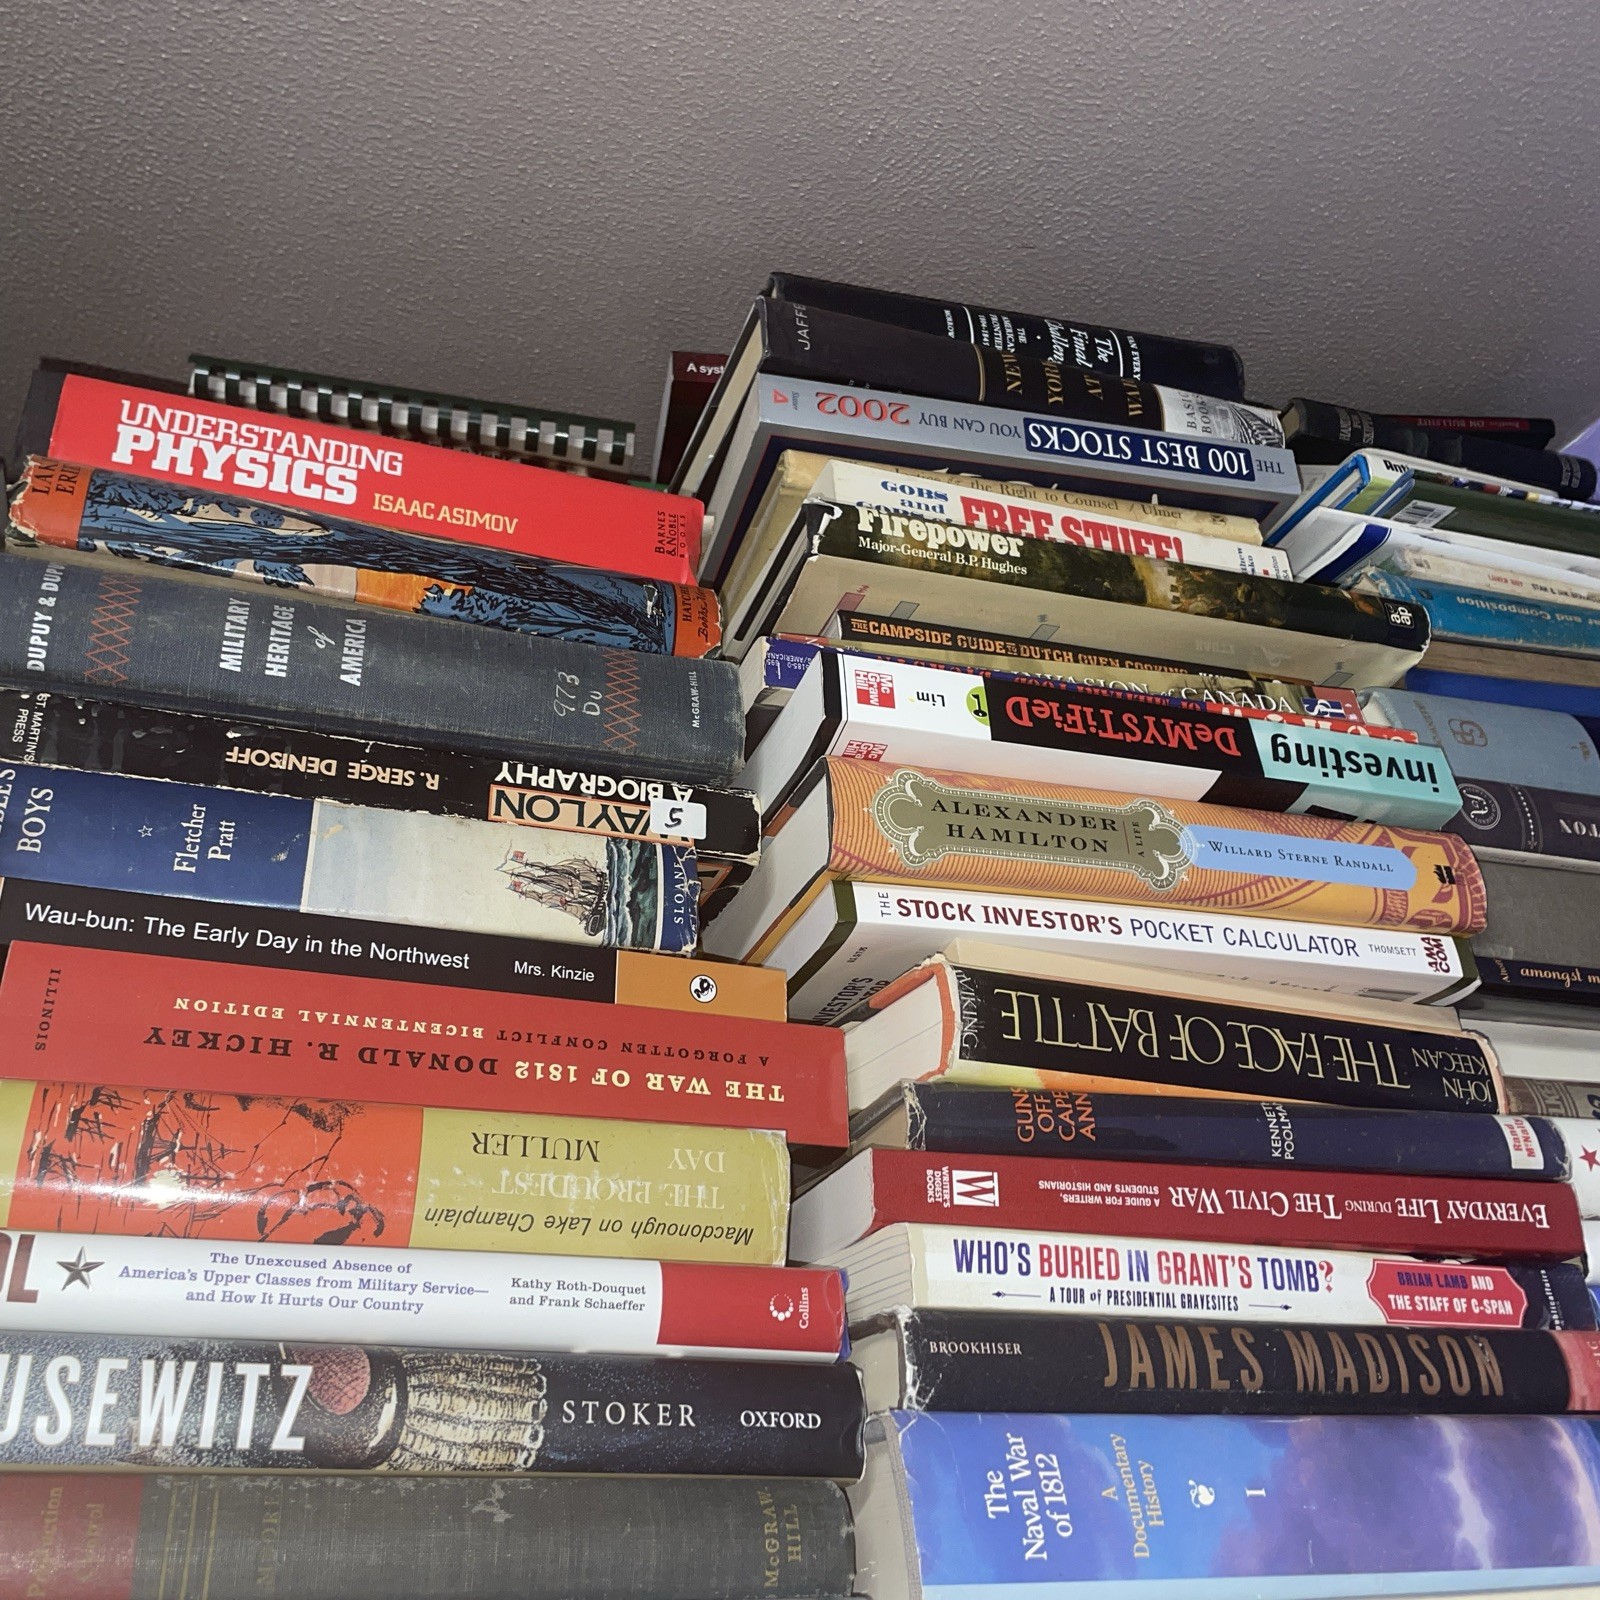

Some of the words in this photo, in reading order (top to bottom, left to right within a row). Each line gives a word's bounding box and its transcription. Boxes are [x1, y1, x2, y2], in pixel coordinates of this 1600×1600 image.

[943, 309, 955, 339] MORROW
[1016, 327, 1028, 344] THE
[1070, 327, 1093, 369] Final
[1094, 336, 1114, 363] The
[1131, 350, 1142, 381] EVERY
[815, 391, 911, 426] 2002
[918, 410, 949, 429] BUY
[120, 399, 403, 477] UNDERSTANDING
[952, 416, 985, 434] CAN
[989, 422, 1021, 440] YOU
[1027, 422, 1133, 461] STOCKS
[1140, 438, 1202, 471] BEST
[1208, 447, 1251, 477] 100
[1255, 458, 1286, 475] THE
[111, 423, 358, 506] PHYSICS
[373, 492, 435, 521] ISAAC
[436, 504, 519, 535] ASIMOV
[880, 480, 949, 502] GOBS
[900, 498, 945, 514] and
[1000, 482, 1039, 500] Right
[1063, 488, 1119, 511] Counsel
[1140, 503, 1184, 521] Ulmer
[655, 510, 666, 555] BARNES
[857, 504, 1025, 559] Firepower
[960, 495, 1055, 543] FREE
[857, 535, 952, 563] Major-General
[980, 553, 1028, 577] Hughes
[1456, 595, 1552, 621] Composition
[26, 611, 53, 672] DUPUY
[219, 597, 251, 673] MILITARY
[264, 604, 296, 678] HERITAGE
[339, 618, 367, 687] AMERICA
[868, 620, 952, 647] CAMPSIDE
[956, 634, 1006, 656] GUIDE
[1019, 643, 1074, 664] DUTCH
[553, 671, 580, 718] 973
[855, 671, 869, 690] Hill
[867, 672, 880, 706] Graw
[691, 670, 701, 729] McGRAW-HILL
[916, 690, 946, 707] Lim
[1181, 686, 1297, 714] CANADA
[12, 708, 30, 743] PRESS
[1005, 696, 1242, 757] DeMYSTiFieD
[225, 746, 338, 777] DENISOFF
[347, 762, 415, 787] SERGE
[1270, 733, 1440, 794] investing
[494, 761, 664, 803] BIOGRAPHY
[16, 787, 54, 853] BOYS
[930, 798, 1119, 834] ALEXANDER
[173, 802, 206, 874] Fletcher
[207, 819, 236, 862] Pratt
[944, 822, 1109, 855] HAMILTON
[1207, 839, 1273, 860] WILLARD
[1277, 847, 1329, 866] STERNE
[1333, 854, 1394, 873] RANDALL
[673, 860, 685, 925] SLOANE
[877, 891, 892, 917] THE
[896, 897, 976, 923] STOCK
[982, 904, 1124, 936] INVESTOR'S
[1129, 917, 1215, 946] POCKET
[1223, 926, 1360, 958] CALCULATOR
[1367, 943, 1418, 957] THOMSETT
[25, 902, 135, 933] Wau-bun:
[143, 915, 186, 939] The
[193, 922, 249, 949] Early
[256, 929, 299, 956] Day
[330, 938, 363, 958] the
[369, 941, 471, 970] Northwest
[513, 959, 546, 978] Mrs.
[551, 963, 596, 983] Kinzie
[1520, 966, 1583, 989] amongst
[34, 968, 61, 1051] ILLINOIS
[173, 997, 284, 1021] EDITION
[298, 1008, 484, 1039] BICENTENNIAL
[958, 977, 979, 1049] VIKING
[993, 988, 1160, 1059] BATTLE
[143, 1025, 293, 1058] HICKEY
[496, 1029, 608, 1052] CONFLICT
[620, 1041, 747, 1066] FORGOTTEN
[1226, 1021, 1325, 1081] FACE
[357, 1046, 498, 1076] DONALD
[514, 1060, 578, 1083] 1812
[1324, 1034, 1411, 1090] THE
[1411, 1047, 1489, 1077] KEEGAN
[591, 1067, 631, 1088] OF
[645, 1072, 712, 1096] WAR
[725, 1079, 785, 1103] THE
[1442, 1076, 1494, 1103] JOHN
[470, 1131, 600, 1163] MULLER
[1504, 1123, 1524, 1152] Rand
[667, 1147, 726, 1174] DAY
[925, 1169, 935, 1204] BOOKS
[933, 1170, 943, 1204] DIGEST
[1038, 1180, 1092, 1192] HISTORIANS
[1060, 1192, 1103, 1205] WRITERS,
[1094, 1182, 1112, 1193] AND
[1104, 1195, 1123, 1206] FOR
[1114, 1184, 1160, 1195] STUDENTS
[1124, 1197, 1152, 1207] GUIDE
[1345, 1199, 1393, 1214] DURING
[1446, 1199, 1550, 1229] EVERYDAY
[424, 1205, 536, 1234] Champlain
[543, 1213, 592, 1237] Lake
[598, 1218, 623, 1234] on
[631, 1219, 755, 1247] Macdonough
[210, 1251, 240, 1266] The
[244, 1253, 328, 1271] Unexcused
[332, 1258, 393, 1274] Absence
[953, 1239, 1032, 1277] WHO'S
[1038, 1243, 1121, 1281] BURIED
[1127, 1248, 1150, 1283] IN
[1156, 1250, 1253, 1290] GRANT'S
[1256, 1256, 1335, 1294] TOMB?
[118, 1265, 198, 1282] America's
[203, 1270, 251, 1287] Upper
[255, 1273, 312, 1289] Classes
[316, 1275, 355, 1290] from
[357, 1277, 417, 1297] Military
[510, 1276, 553, 1295] Kathy
[556, 1279, 647, 1298] Roth-Douquet
[1396, 1271, 1433, 1288] BRIAN
[1435, 1274, 1469, 1290] LAMB
[1470, 1275, 1495, 1291] AND
[185, 1289, 216, 1303] and
[220, 1290, 257, 1304] How
[278, 1293, 324, 1307] Hurts
[327, 1295, 359, 1310] Our
[363, 1297, 424, 1316] Country
[508, 1294, 535, 1308] and
[539, 1295, 581, 1310] Frank
[583, 1297, 646, 1312] Schaeffer
[797, 1286, 810, 1330] Collins
[1058, 1286, 1086, 1305] TOUR
[1106, 1289, 1178, 1310] PRESIDENTIAL
[1179, 1292, 1240, 1312] GRAVESITES
[1388, 1294, 1413, 1311] THE
[1415, 1295, 1450, 1313] STAFF
[1452, 1297, 1468, 1313] OF
[1471, 1298, 1514, 1316] C-SPAN
[929, 1340, 1022, 1356] BROOKHISER
[1098, 1322, 1264, 1391] JAMES
[1281, 1328, 1504, 1397] MADISON
[561, 1399, 696, 1428] STOKER
[739, 1409, 822, 1430] OXFORD
[1006, 1432, 1028, 1483] War
[984, 1469, 1010, 1519] The
[1034, 1453, 1069, 1509] 1812
[1111, 1433, 1151, 1559] Documentary
[1137, 1459, 1165, 1527] History
[1013, 1488, 1048, 1561] Naval
